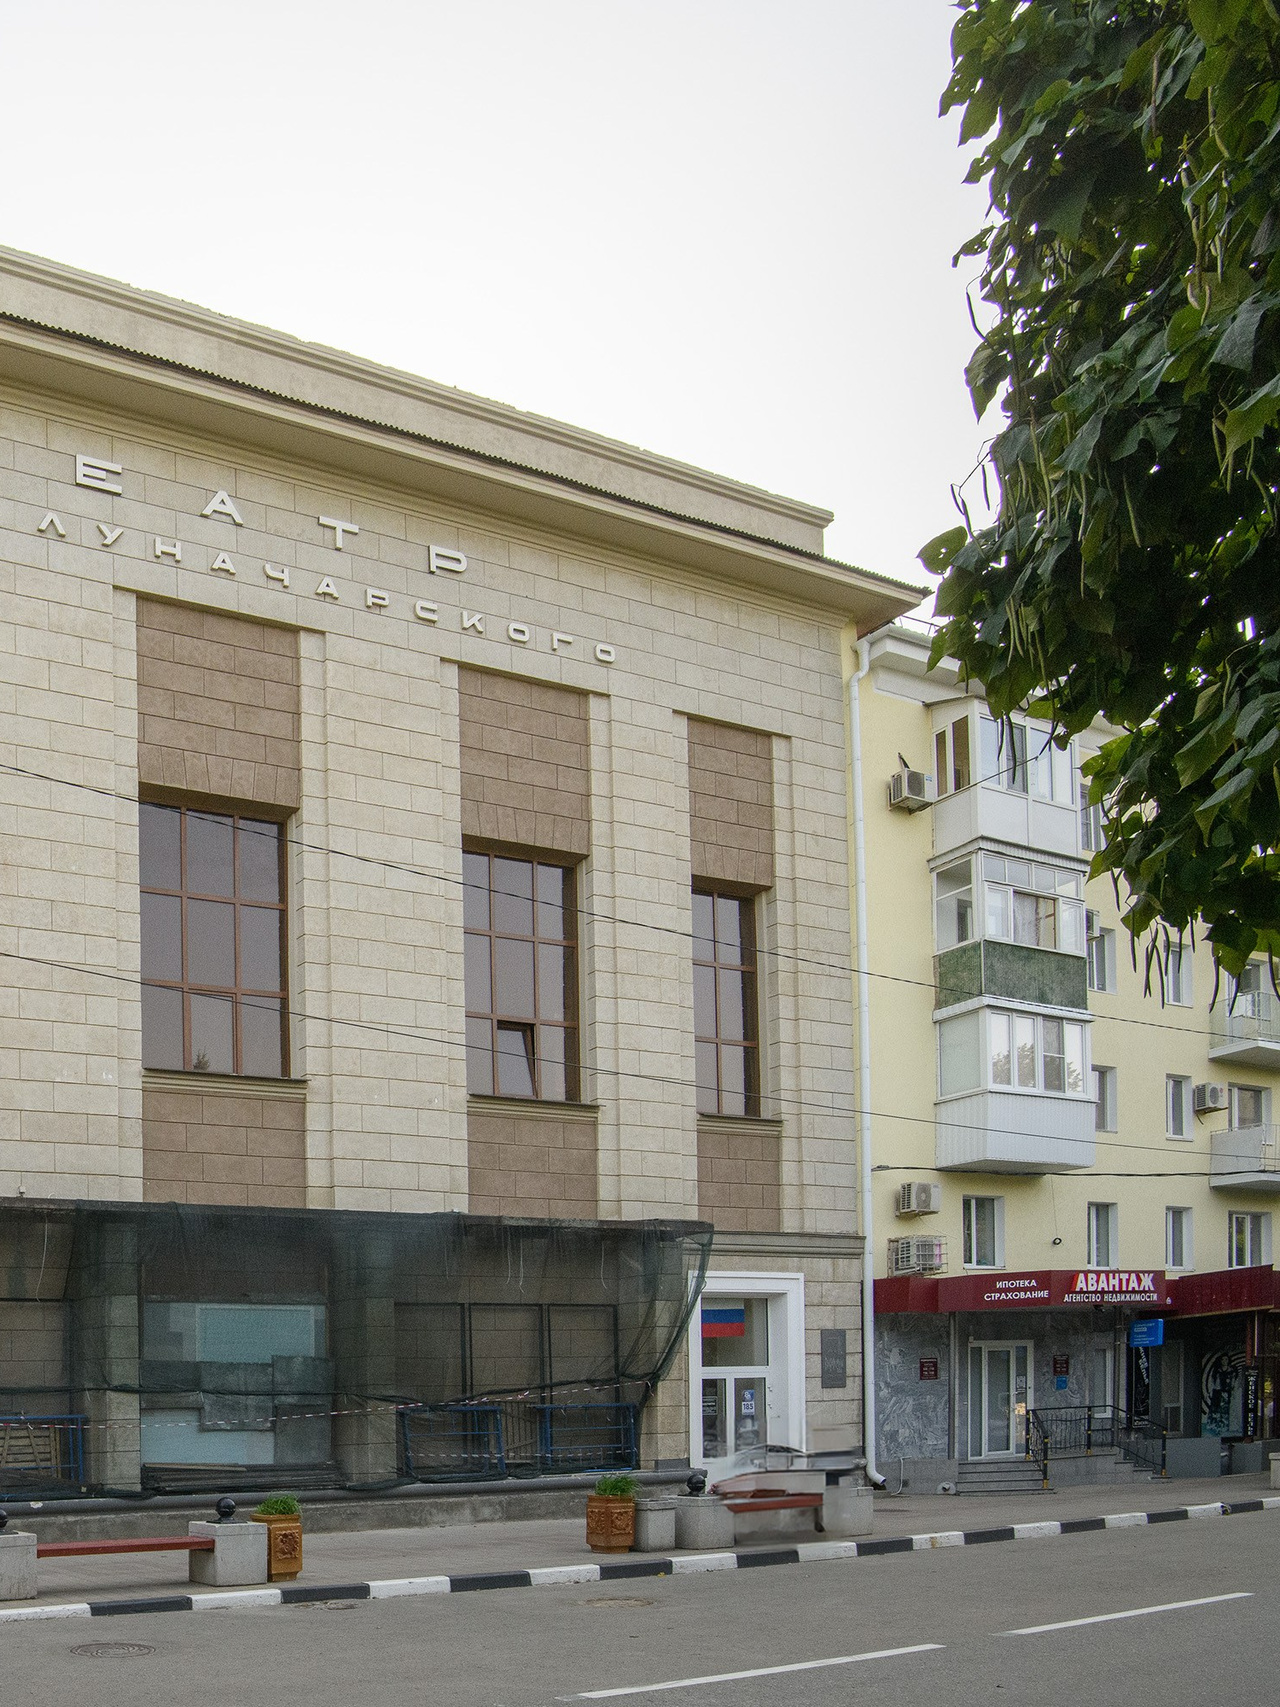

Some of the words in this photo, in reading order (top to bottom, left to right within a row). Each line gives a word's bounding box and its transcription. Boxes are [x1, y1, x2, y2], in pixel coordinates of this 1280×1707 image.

[37, 511, 618, 664] ЛУНАЧАРСКОГО
[996, 1279, 1037, 1288] ИПОТЕКА
[1072, 1272, 1154, 1292] АВАНТАЖ
[984, 1290, 1049, 1301] СТРАХОВАНИЕ
[1063, 1293, 1102, 1303] АГЕНТСТВО
[1104, 1293, 1158, 1302] НЕДВИЖИМОСТИ
[743, 1402, 754, 1410] 185
